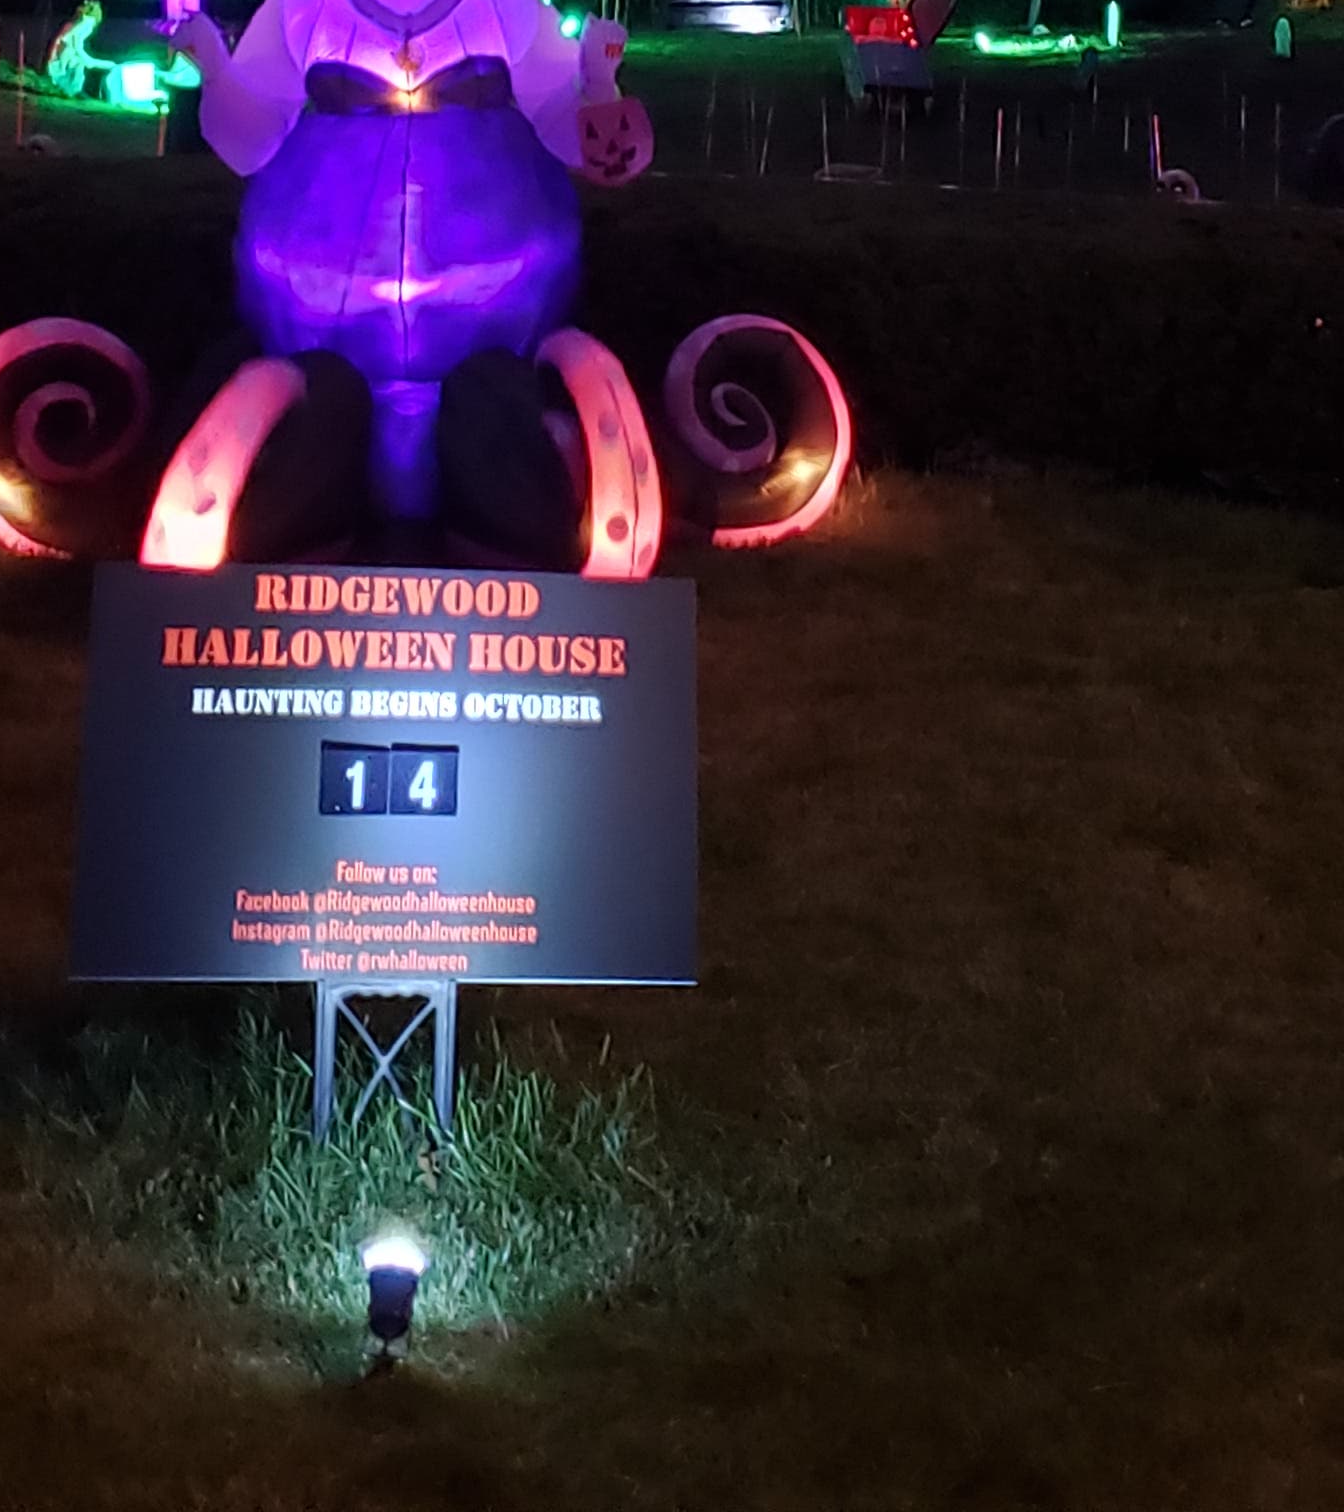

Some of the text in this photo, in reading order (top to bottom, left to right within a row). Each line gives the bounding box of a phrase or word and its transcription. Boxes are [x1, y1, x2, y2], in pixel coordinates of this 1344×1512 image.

[254, 573, 542, 618] RIDGEWOOD
[161, 627, 628, 675] HALLOWEEN HOUSE
[191, 687, 603, 723] HAUNTING BEGINS OCTOBER
[336, 861, 438, 886] Follow us on:
[235, 890, 537, 919] Facebook @Ridgewoodhalloweenhouse
[231, 920, 539, 949] Instagram @Ridgewoodhalloweenhouse
[299, 950, 469, 974] Twitter @rwhalloween
